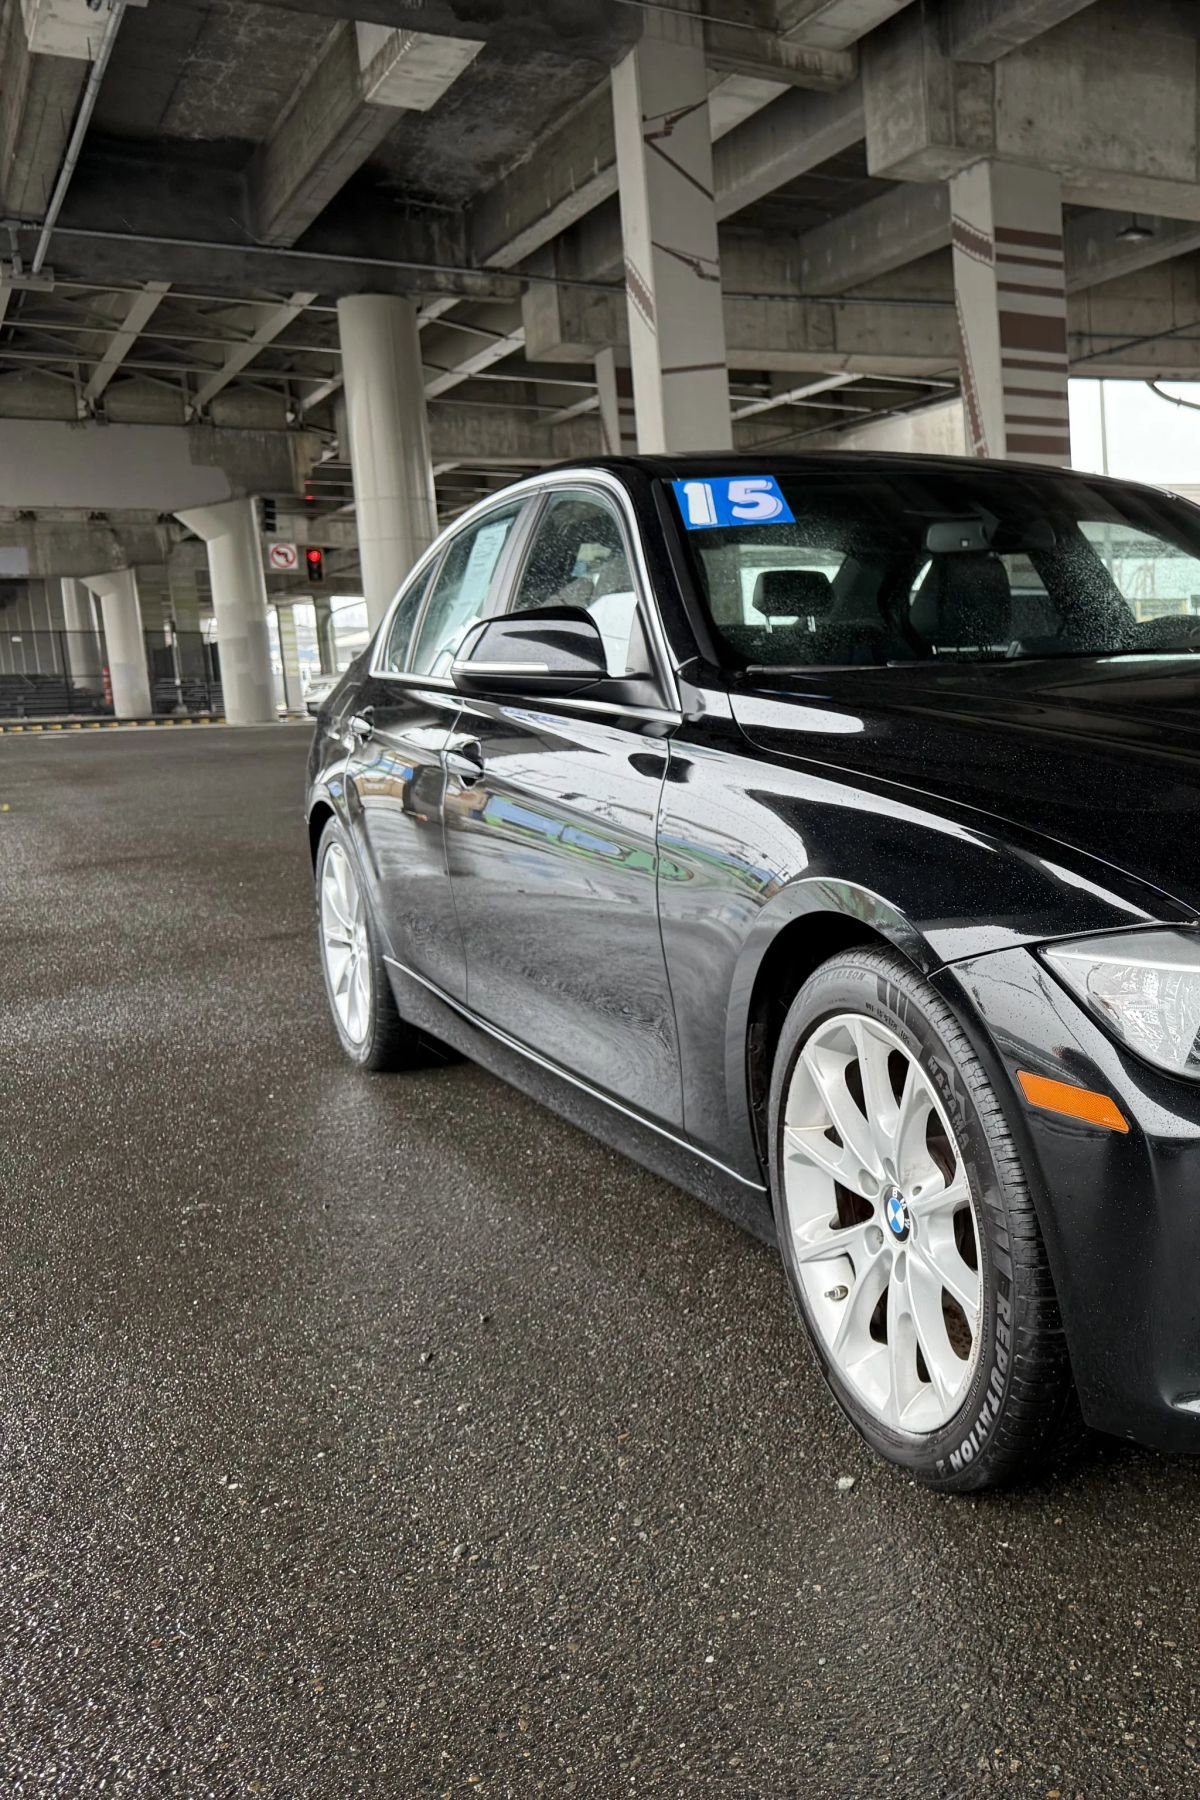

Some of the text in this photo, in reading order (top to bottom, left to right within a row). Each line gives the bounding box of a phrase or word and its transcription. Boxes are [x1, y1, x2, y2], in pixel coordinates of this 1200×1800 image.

[683, 480, 783, 525] 15
[927, 1055, 970, 1150] MAZAMA
[949, 1290, 1012, 1473] REPUTATION
